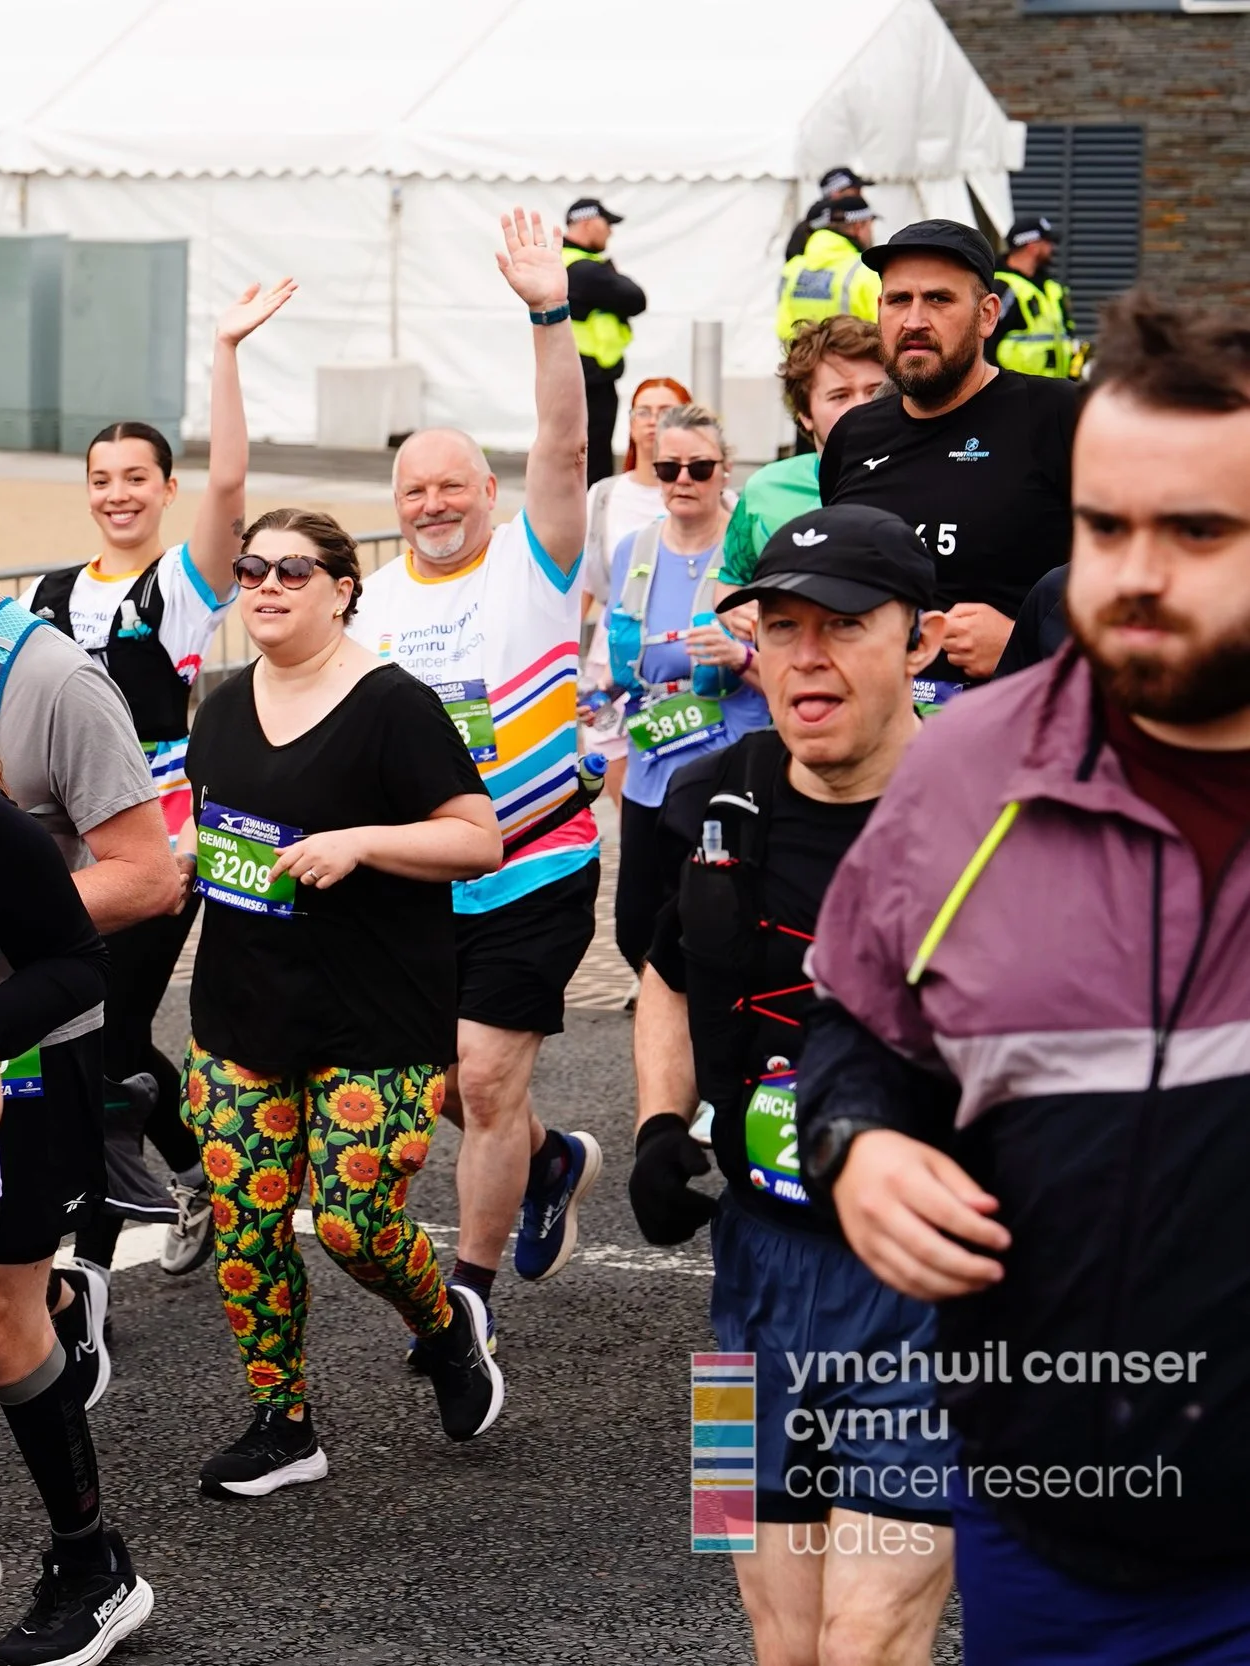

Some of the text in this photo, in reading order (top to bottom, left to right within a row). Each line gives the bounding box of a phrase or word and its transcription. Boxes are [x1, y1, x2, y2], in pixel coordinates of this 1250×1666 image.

[398, 641, 445, 656] cymru
[646, 705, 703, 743] 3819
[245, 817, 281, 836] SWANSEA
[198, 831, 238, 853] GEMMA
[211, 851, 271, 893] 3209
[207, 887, 268, 913] #RUNSWANSEA
[92, 1582, 129, 1629] HOKA
